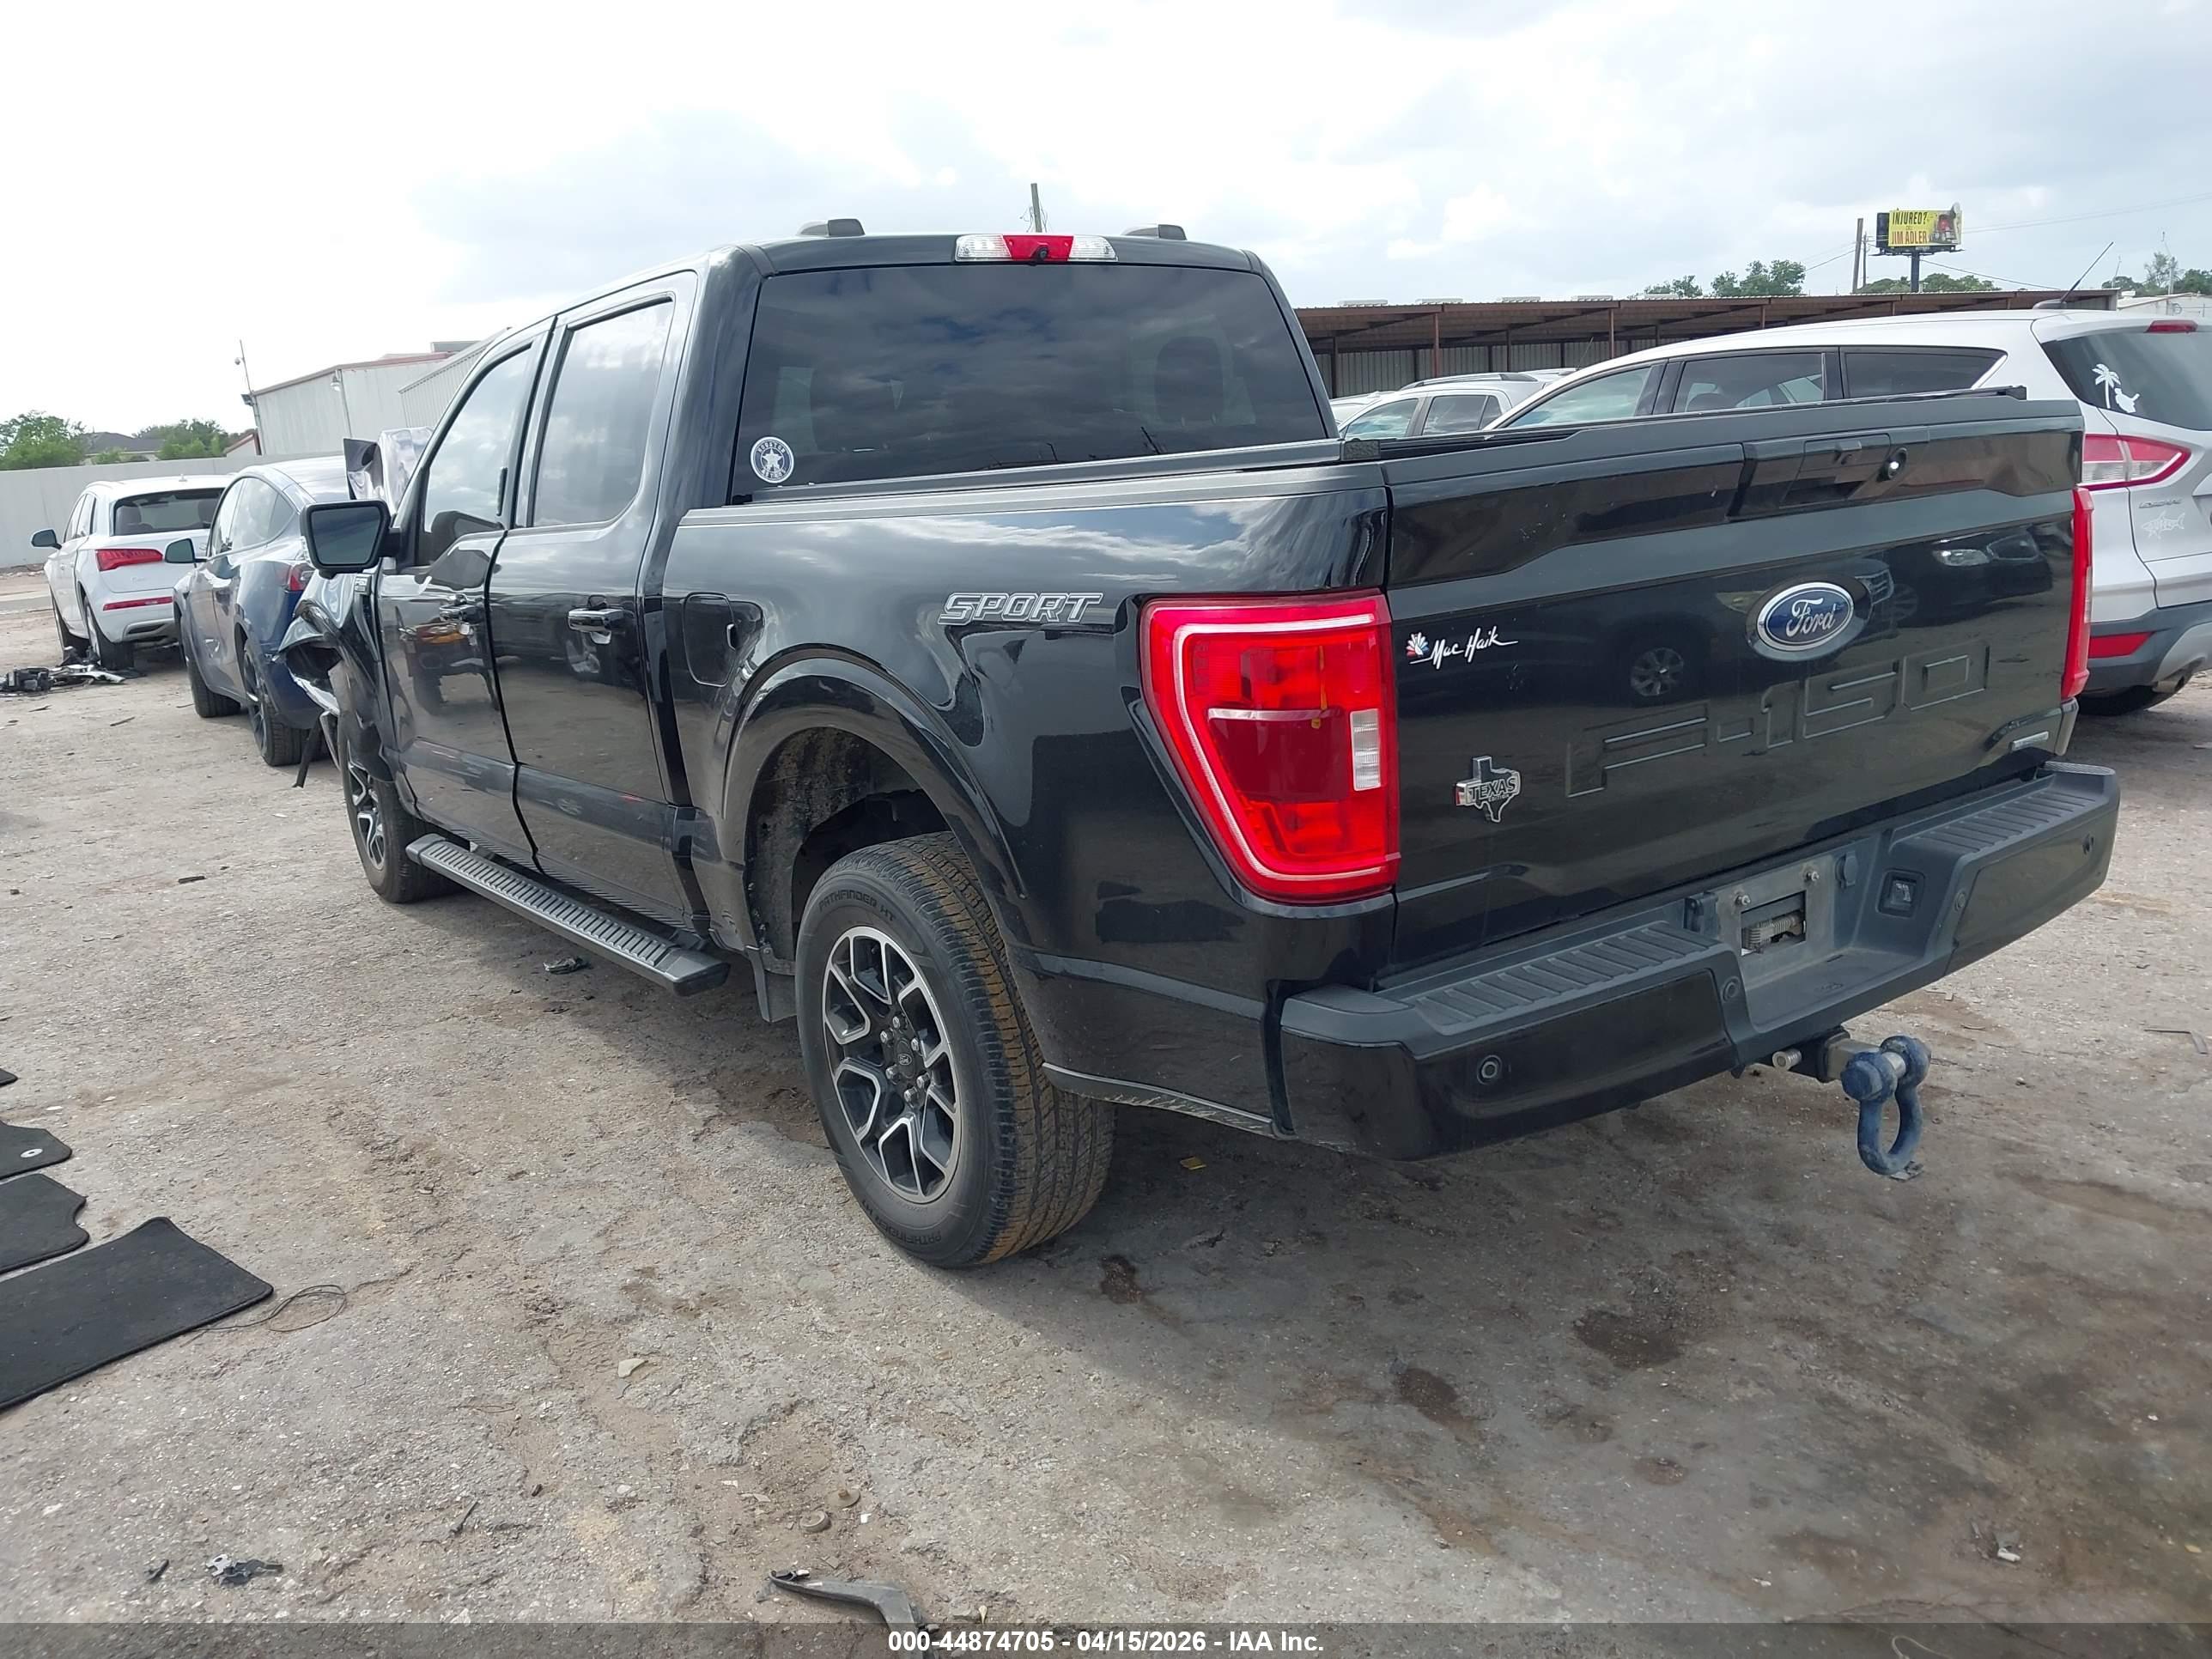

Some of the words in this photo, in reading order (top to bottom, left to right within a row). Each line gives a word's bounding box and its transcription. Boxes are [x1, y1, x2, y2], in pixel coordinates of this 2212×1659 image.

[1893, 211, 1928, 225] INJURED?
[1892, 231, 1904, 245] JIM
[1905, 230, 1928, 245] ADLER
[938, 592, 1103, 625] SPORT
[1786, 598, 1837, 637] Ford
[1409, 639, 1464, 670] Mac
[1465, 625, 1519, 663] Haik
[1566, 645, 1990, 799] F-150
[1468, 776, 1516, 801] TEXAS
[818, 890, 877, 911] PATHFINDER
